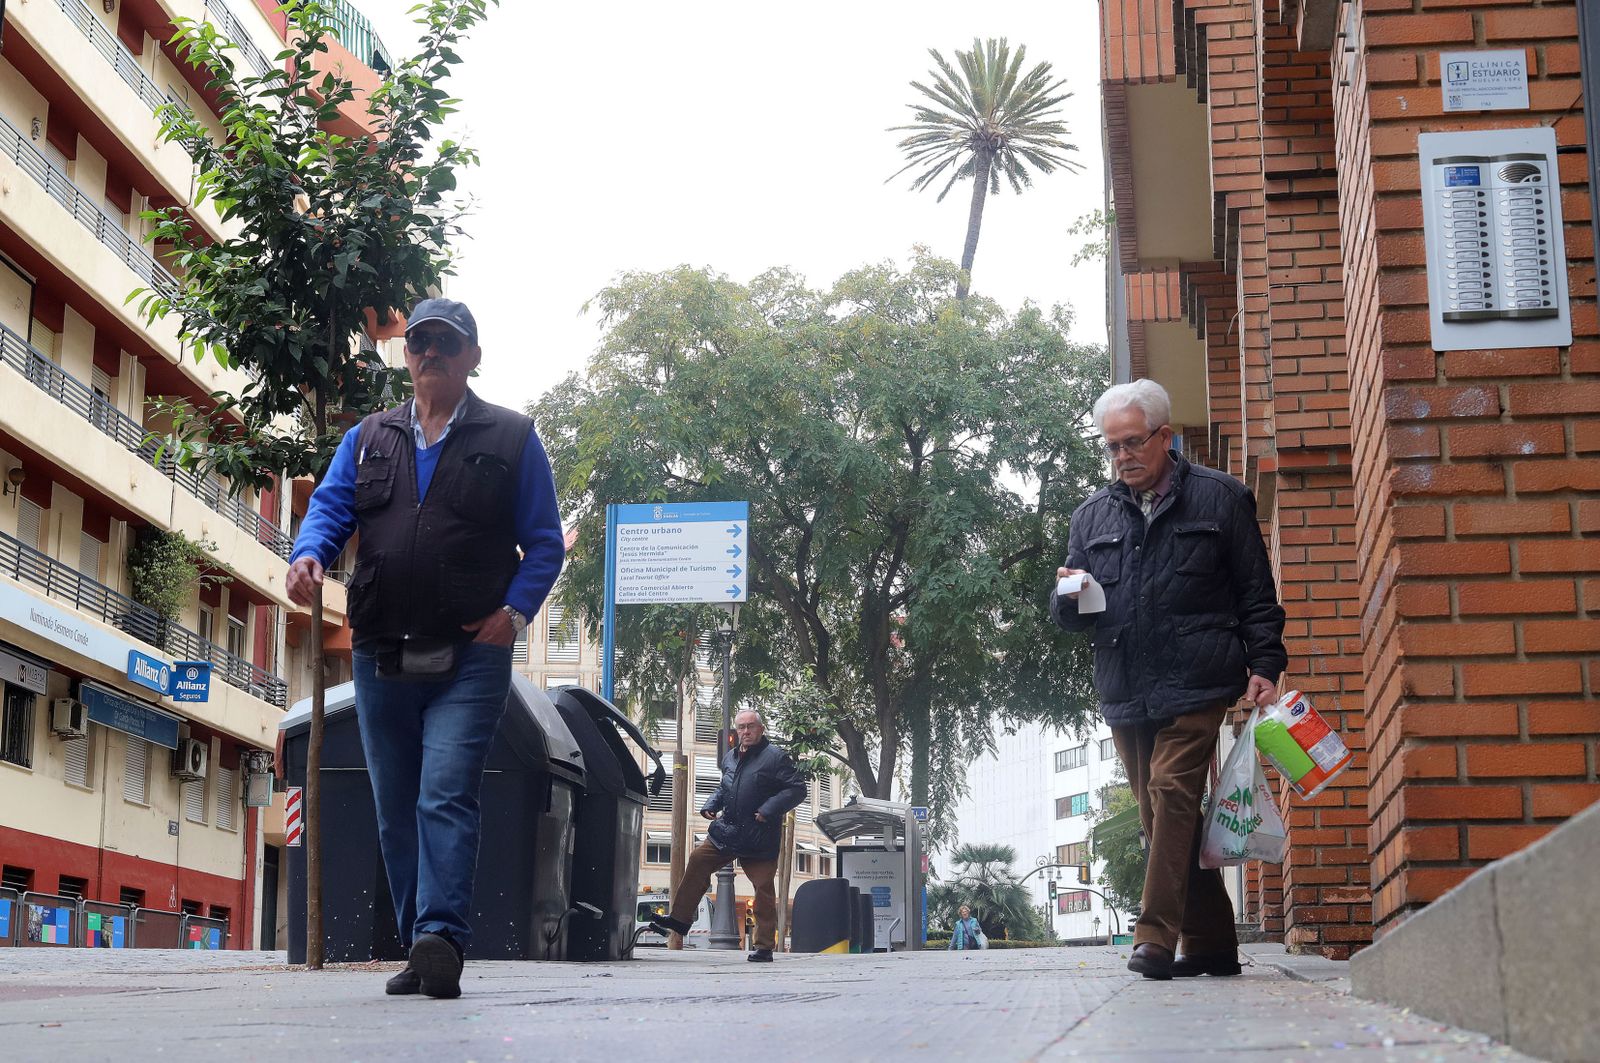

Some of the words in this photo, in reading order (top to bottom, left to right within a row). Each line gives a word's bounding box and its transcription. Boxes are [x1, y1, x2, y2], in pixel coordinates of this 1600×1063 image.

[1472, 68, 1521, 78] ESTUARIO
[651, 526, 682, 535] urbano
[645, 566, 678, 574] Municipal
[134, 657, 159, 683] Allianz
[176, 680, 207, 691] Allianz
[179, 692, 201, 701] Seguros
